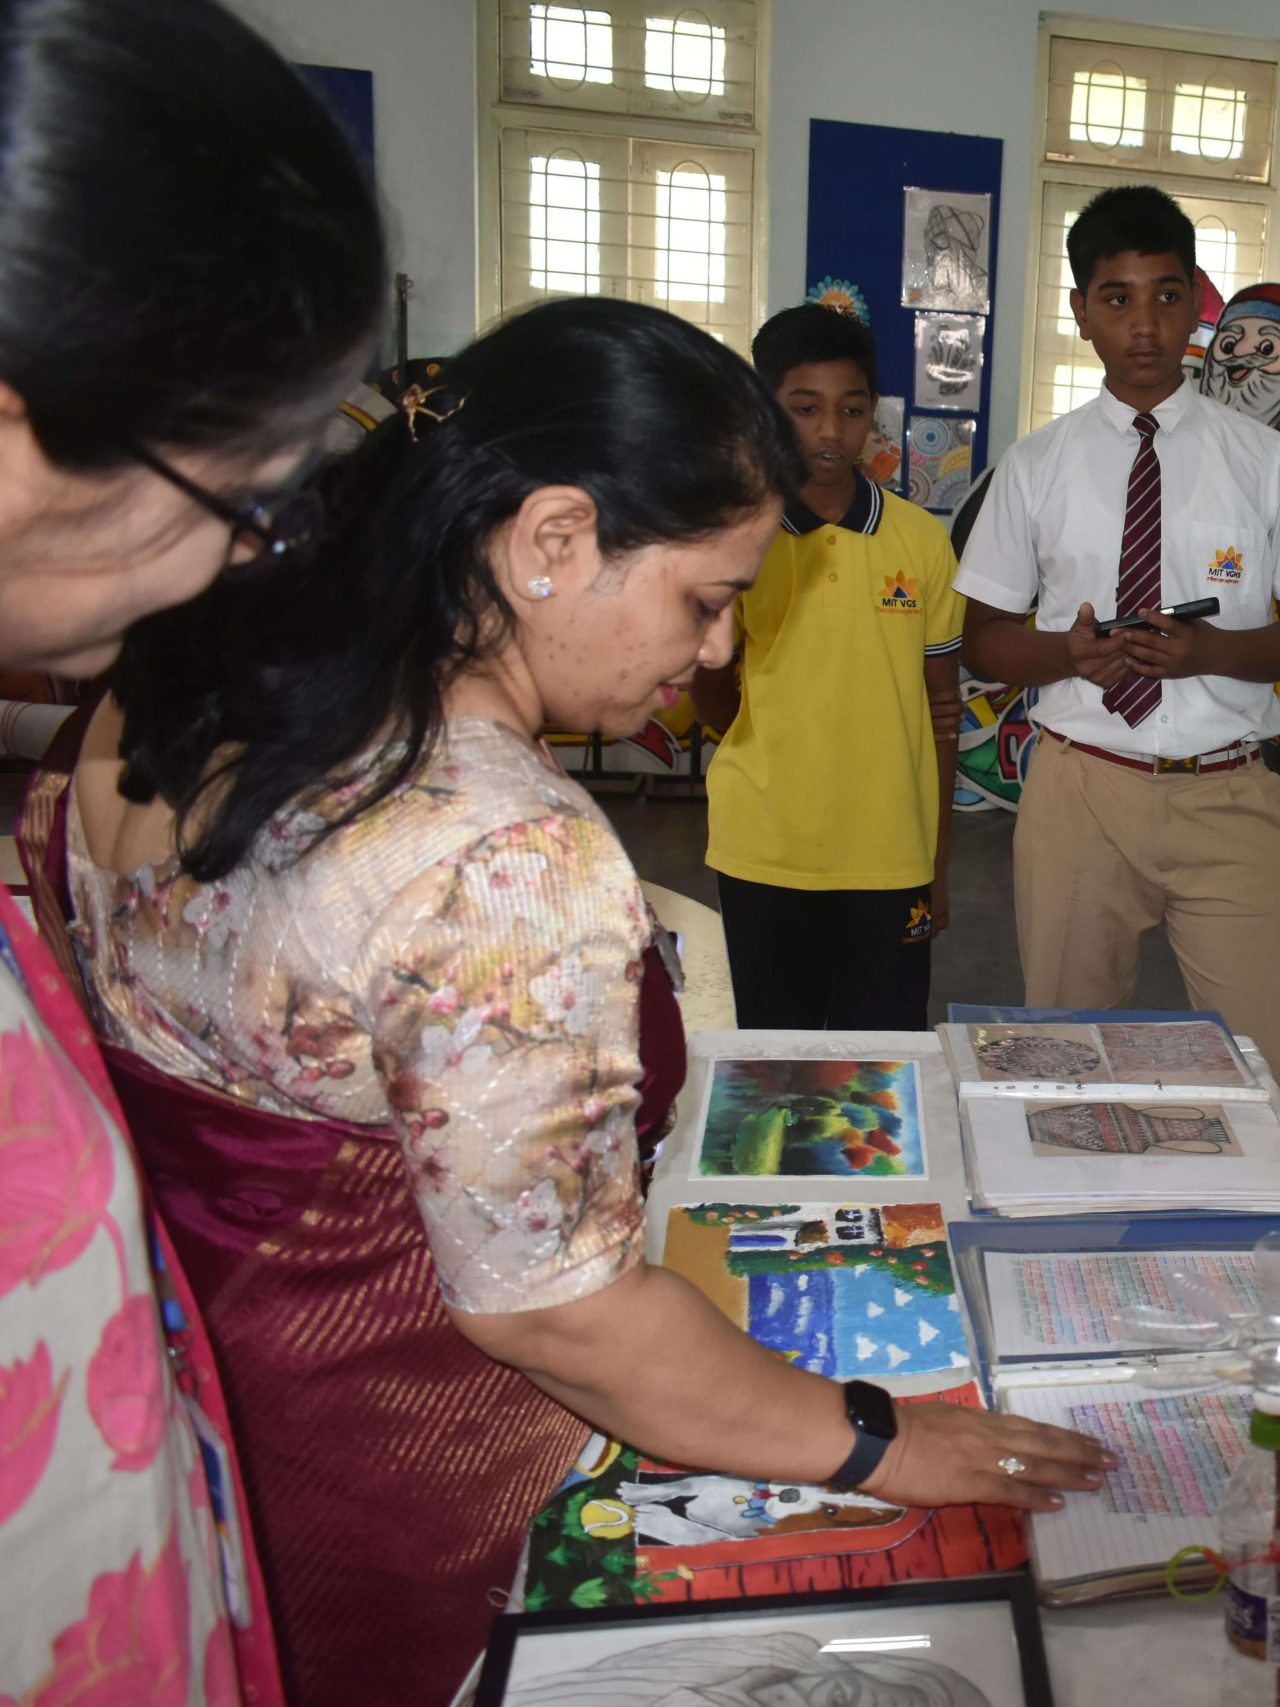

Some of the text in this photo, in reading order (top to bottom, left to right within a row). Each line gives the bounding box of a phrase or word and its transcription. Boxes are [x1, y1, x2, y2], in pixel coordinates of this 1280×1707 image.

[1208, 567, 1224, 576] MIT
[882, 598, 917, 608] MIT VGS
